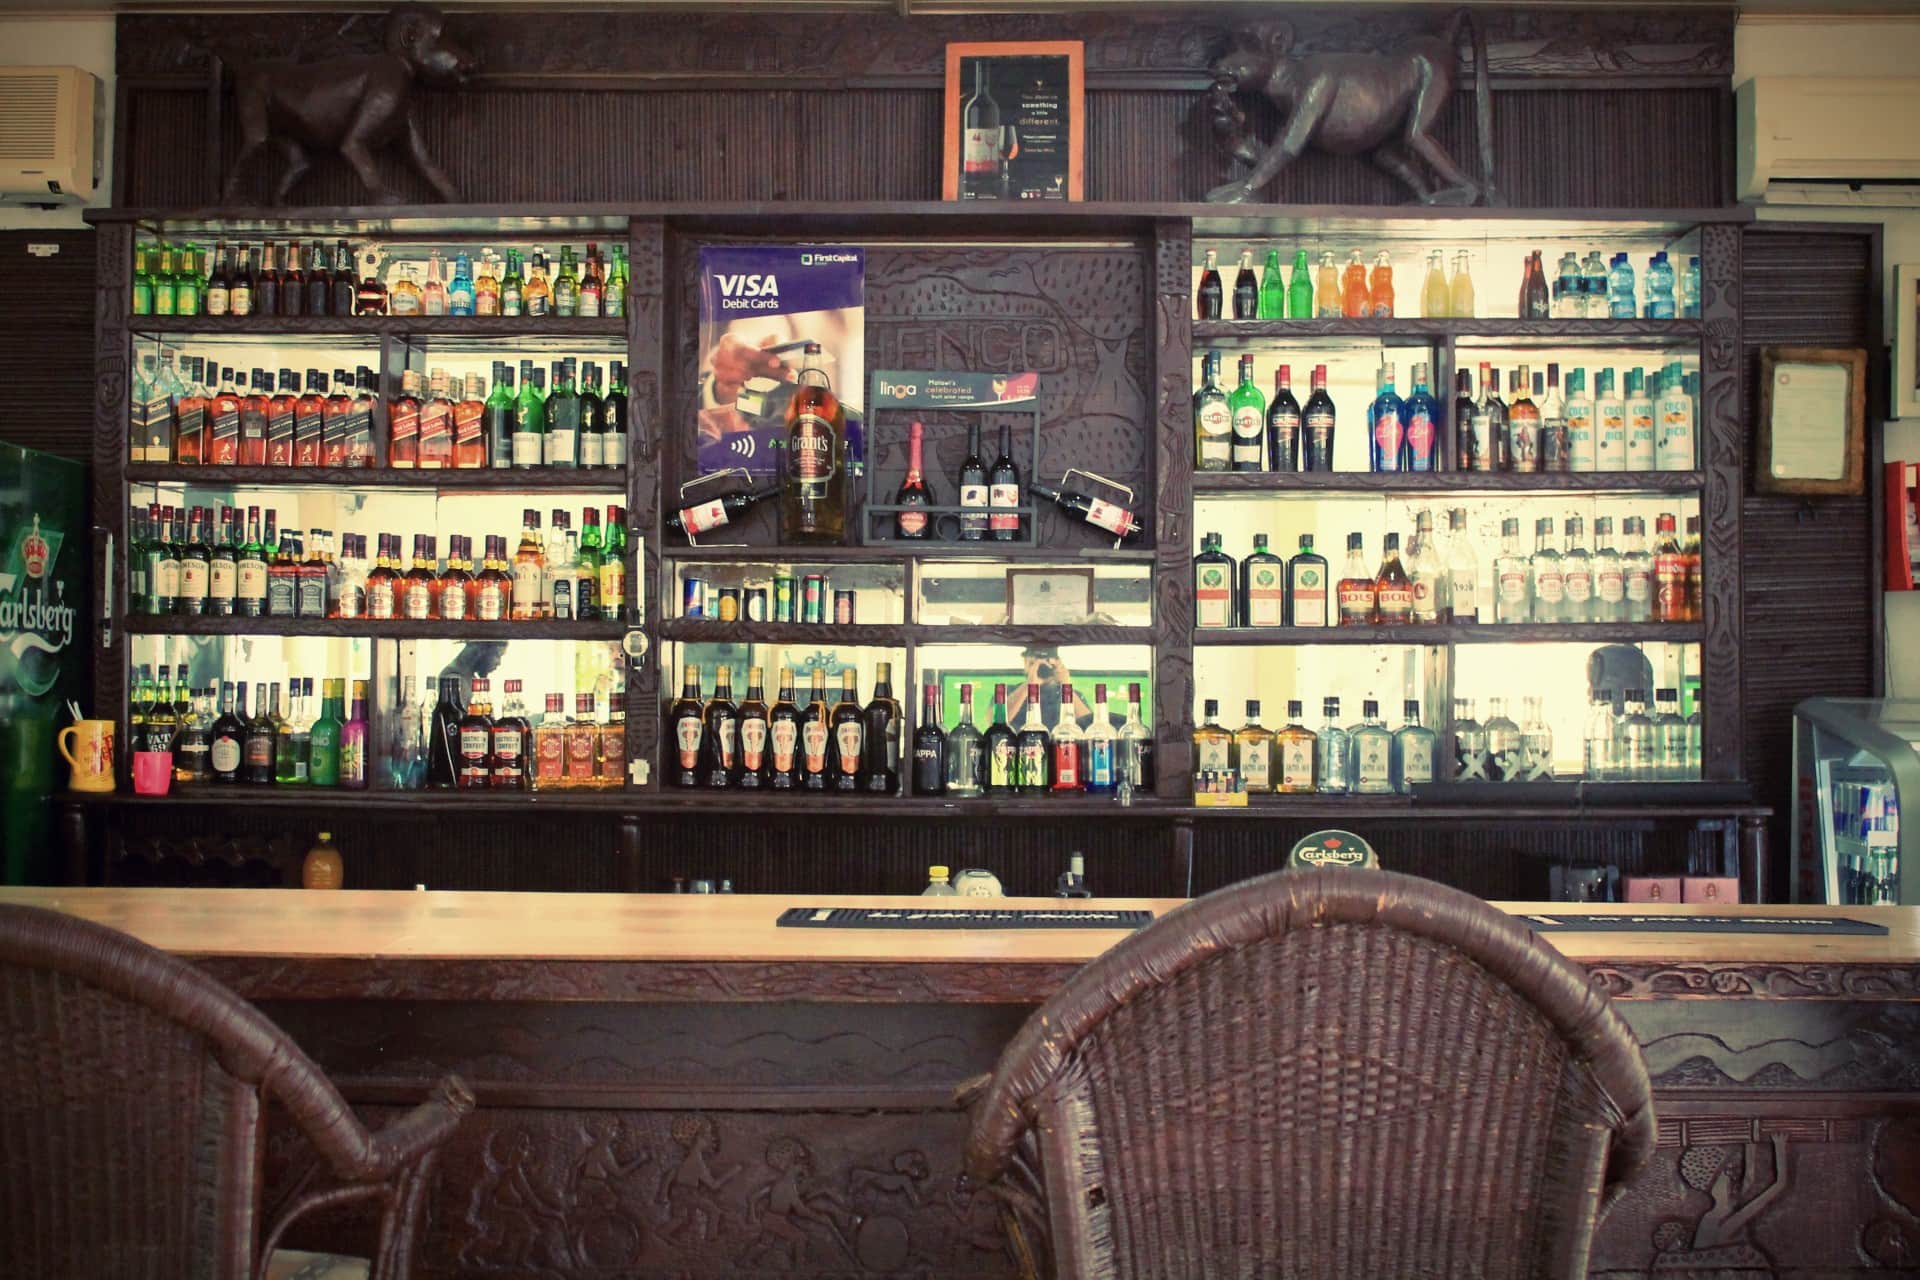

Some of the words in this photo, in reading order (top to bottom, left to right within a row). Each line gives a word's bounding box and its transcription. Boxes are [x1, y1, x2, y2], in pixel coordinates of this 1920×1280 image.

[713, 274, 779, 297] VISA
[722, 298, 750, 309] Debit
[750, 298, 779, 310] Cards
[880, 380, 917, 399] linga
[926, 386, 972, 394] celebrated
[791, 434, 829, 453] Grant's
[147, 733, 171, 745] VAT
[914, 748, 938, 759] APPA
[1299, 846, 1364, 864] Carlsberg
